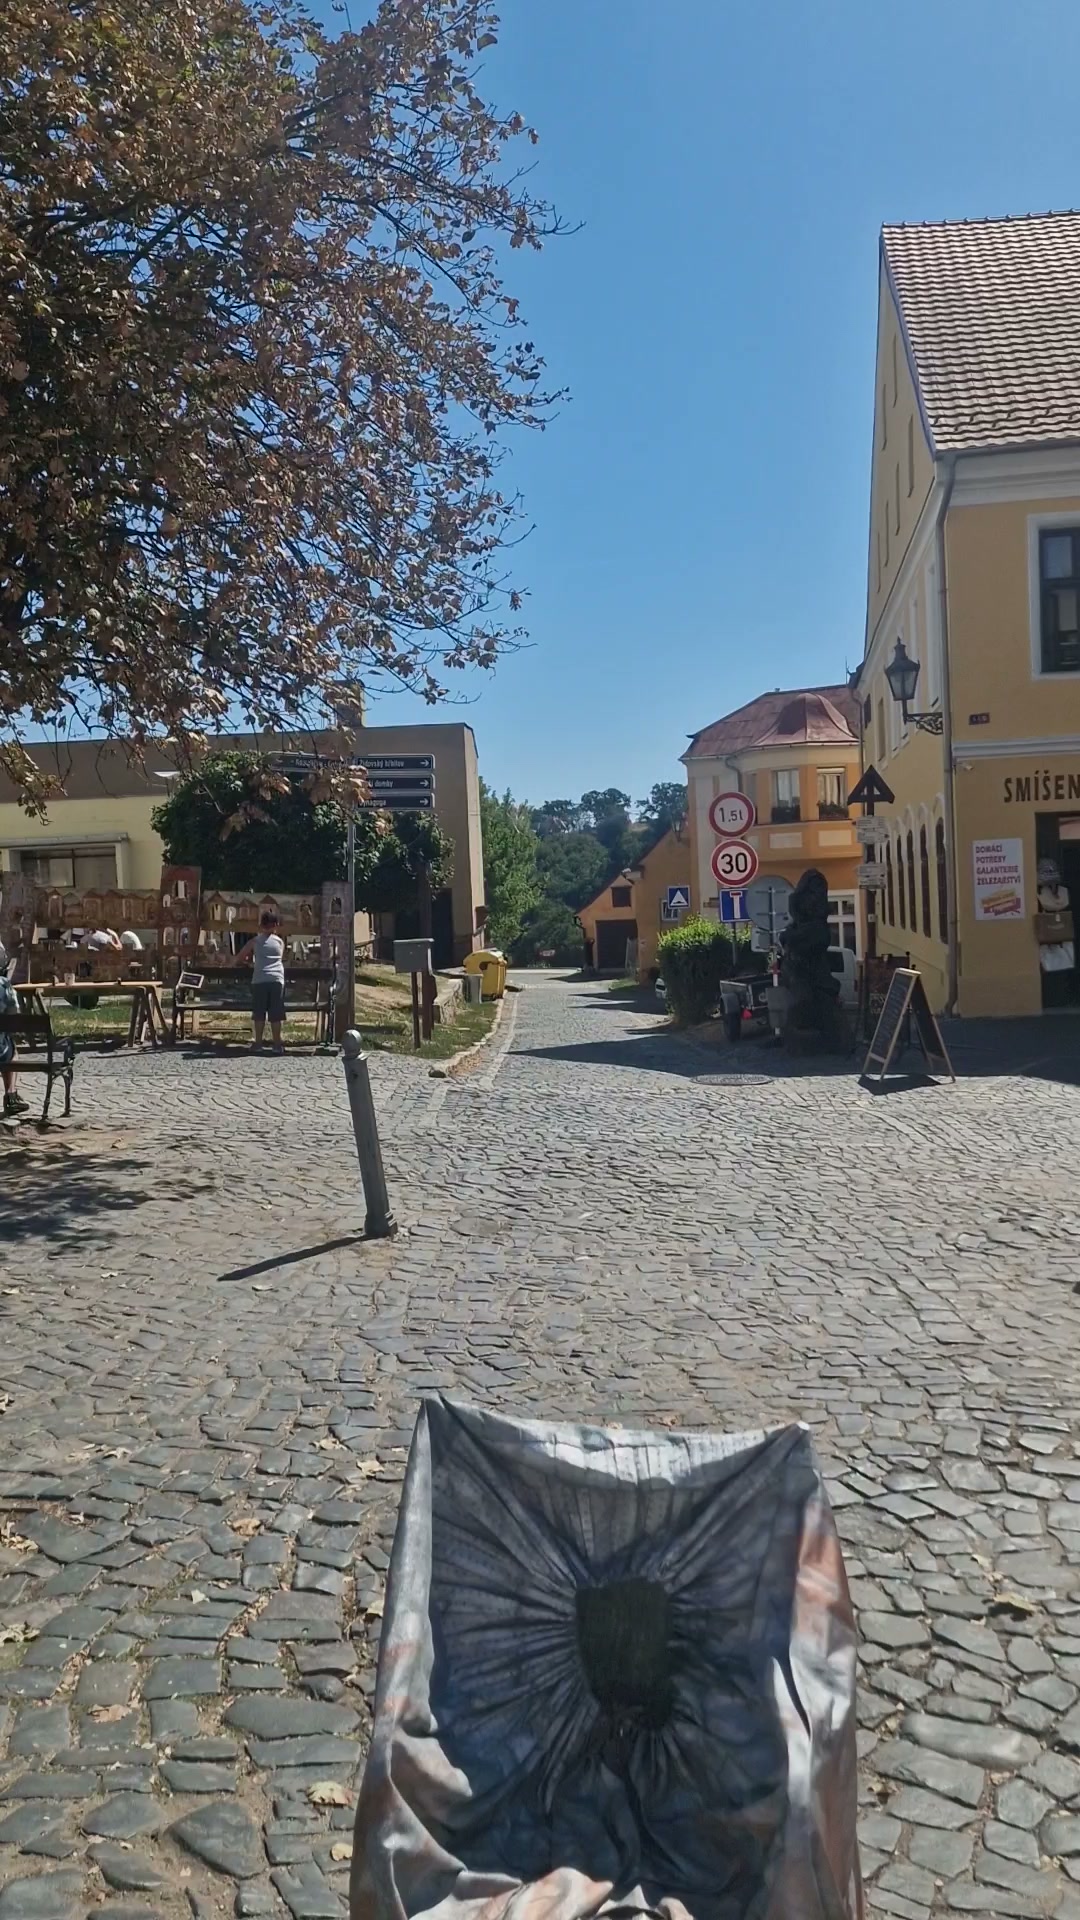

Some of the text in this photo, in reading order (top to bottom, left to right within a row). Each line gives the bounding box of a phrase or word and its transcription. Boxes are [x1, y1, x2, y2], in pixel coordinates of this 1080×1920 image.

[1003, 769, 1080, 803] SMÍŠEN
[720, 852, 748, 875] 30
[976, 865, 1019, 875] GALANTERIE
